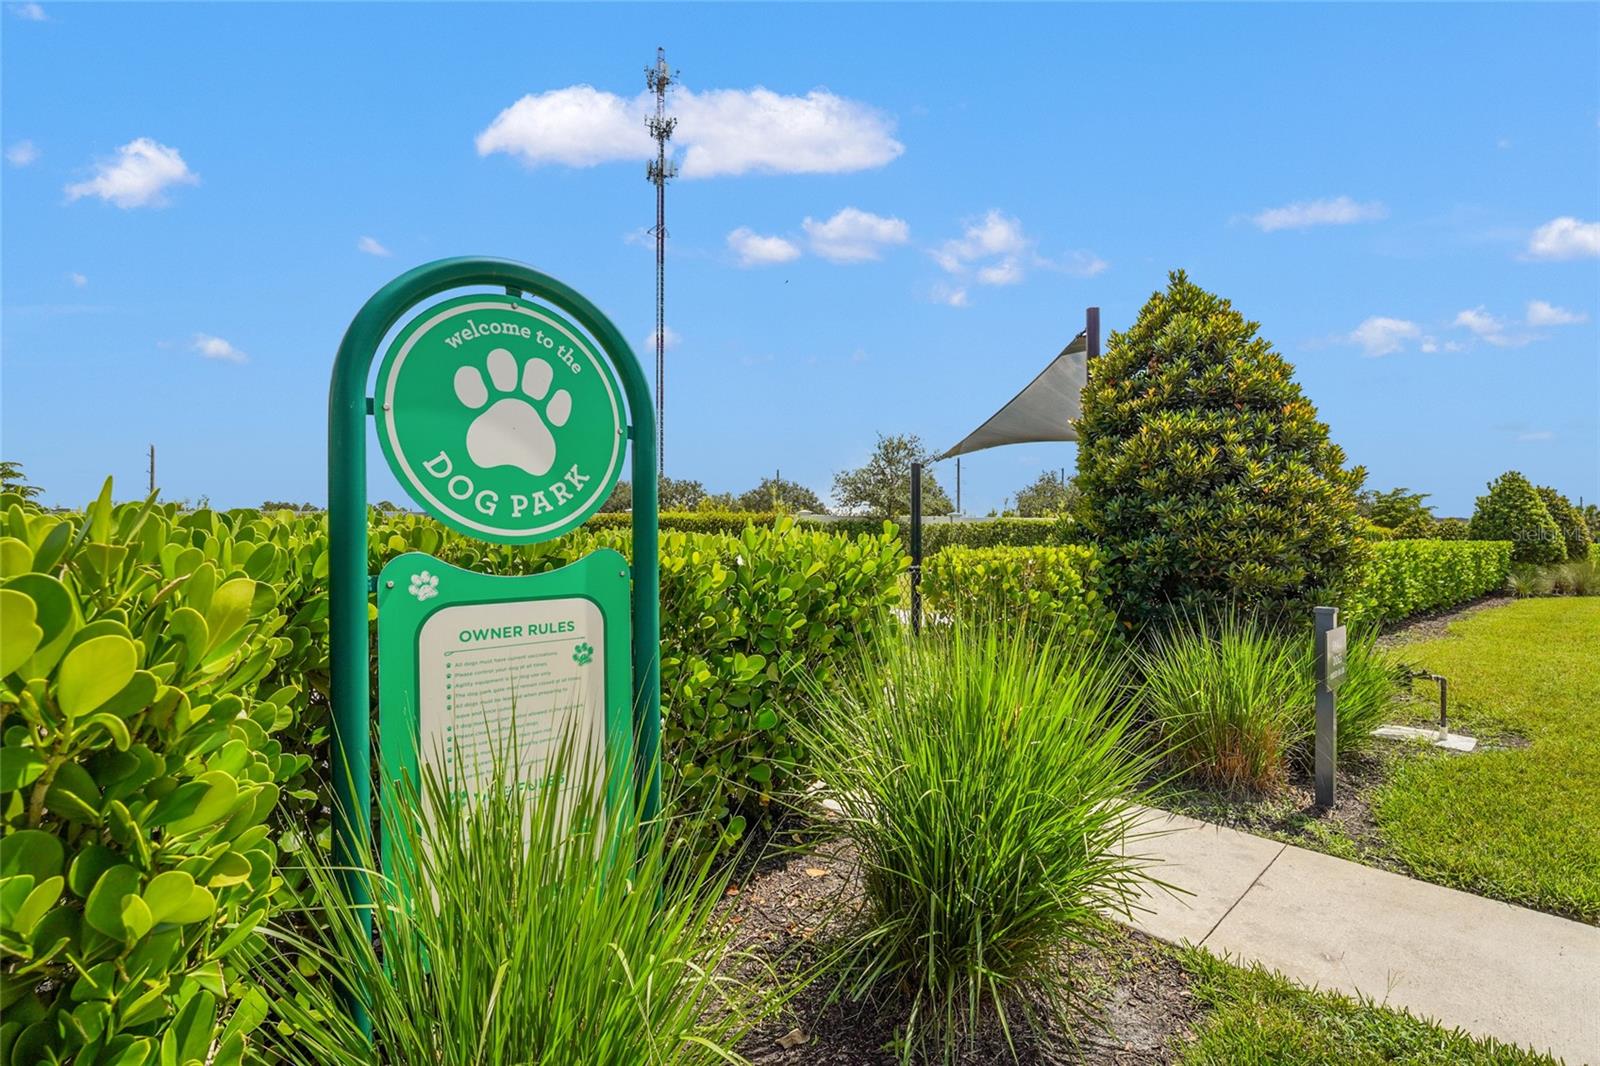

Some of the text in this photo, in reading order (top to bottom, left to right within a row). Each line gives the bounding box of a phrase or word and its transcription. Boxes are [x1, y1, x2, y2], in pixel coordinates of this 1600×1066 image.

[445, 320, 581, 374] welcome to the
[423, 451, 591, 518] DOG PARK
[459, 621, 575, 642] OWNER RULES
